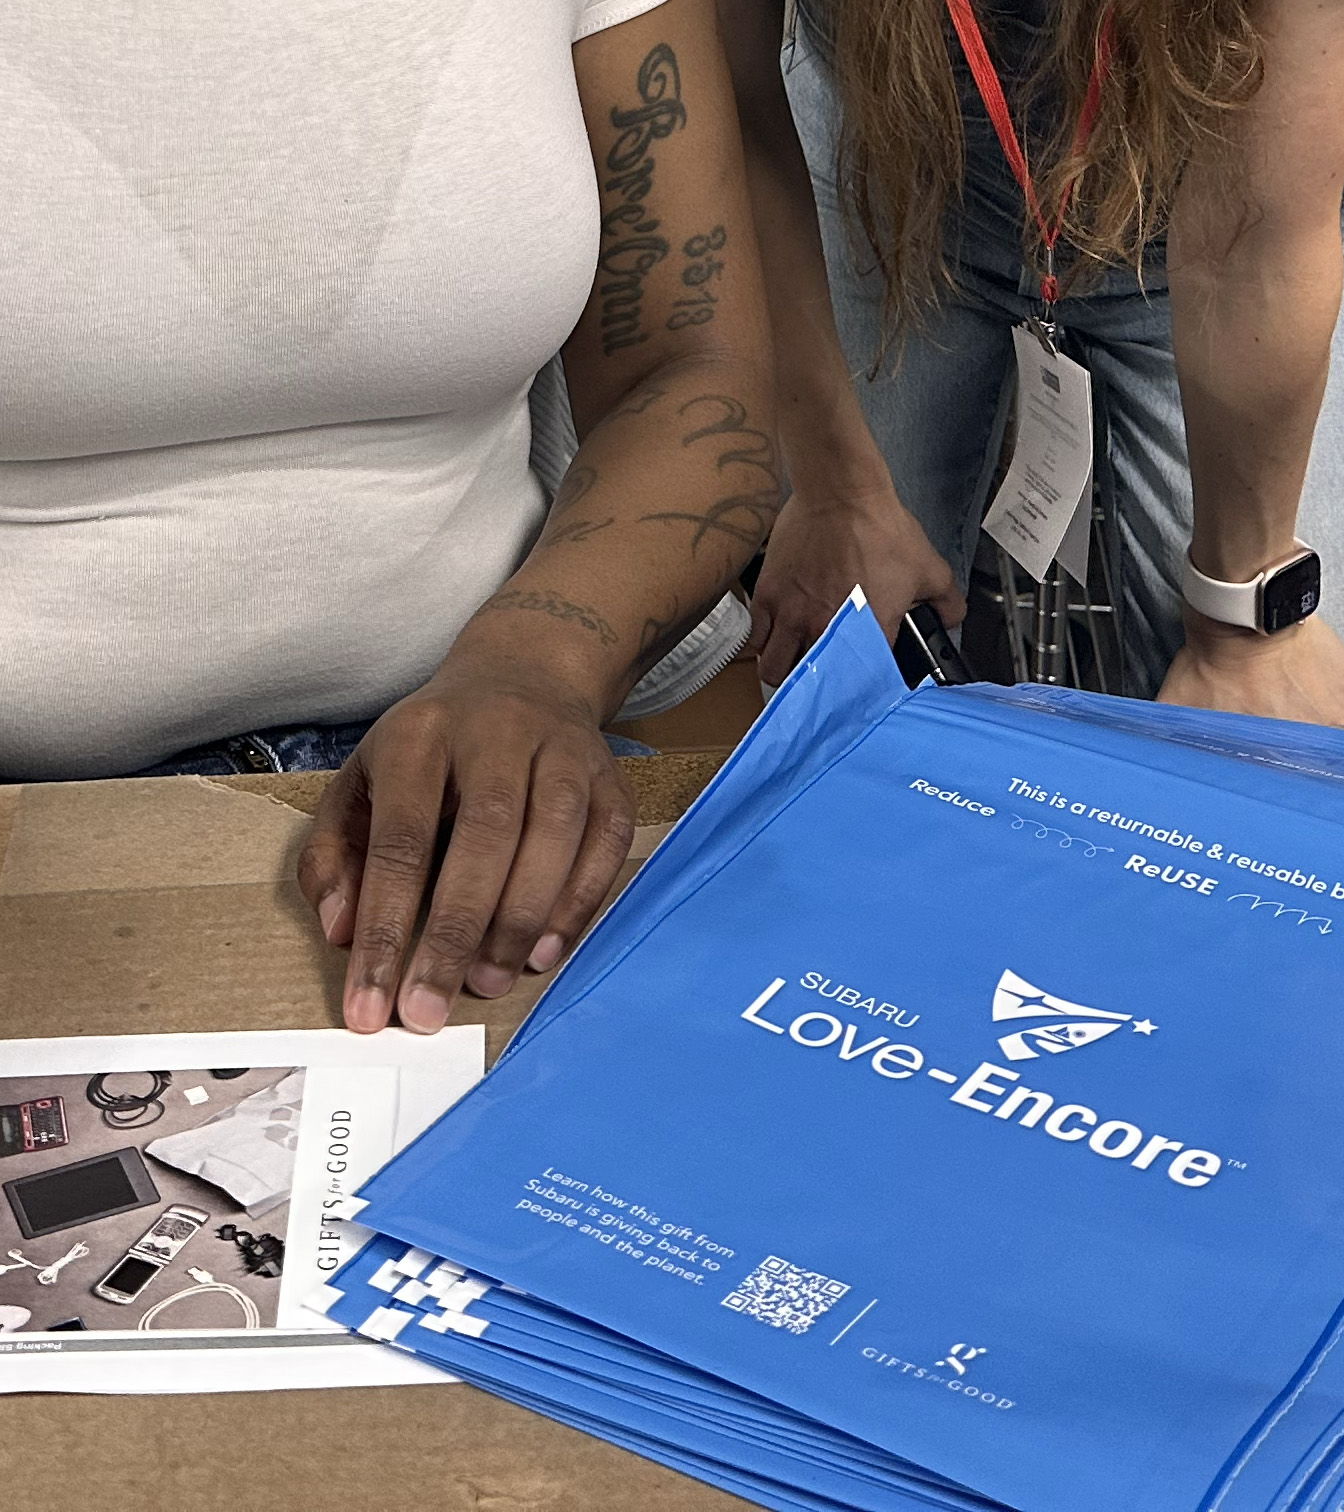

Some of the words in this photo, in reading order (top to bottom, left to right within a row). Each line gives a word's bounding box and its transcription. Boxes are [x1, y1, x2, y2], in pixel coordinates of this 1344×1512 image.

[908, 776, 997, 819] Reduce
[1123, 853, 1220, 896] ReUSE
[1006, 776, 1047, 805] This
[1049, 790, 1068, 810] is
[1070, 799, 1087, 816] a
[1088, 802, 1205, 854] returnable
[1206, 842, 1224, 861] &
[1227, 849, 1327, 896] reusable
[799, 969, 922, 1029] SUBARU
[740, 976, 1223, 1189] Love-Encore
[326, 1109, 352, 1174] GOOD
[327, 1176, 344, 1196] for
[523, 1178, 584, 1211] Subaru
[585, 1202, 601, 1218] is
[598, 1212, 656, 1247] giving
[656, 1237, 700, 1264] back
[701, 1257, 721, 1272] to
[541, 1166, 589, 1193] Learn
[589, 1185, 629, 1209] how
[629, 1203, 662, 1227] this
[658, 1222, 694, 1242] gift
[693, 1233, 736, 1259] from
[316, 1199, 344, 1272] GIFTS
[514, 1198, 579, 1229] people
[578, 1222, 617, 1245] and
[614, 1239, 645, 1260] the
[642, 1254, 705, 1287] planet.
[15, 1341, 63, 1351] Packing
[861, 1346, 929, 1380] GIFTS
[946, 1379, 1014, 1410] GOOD
